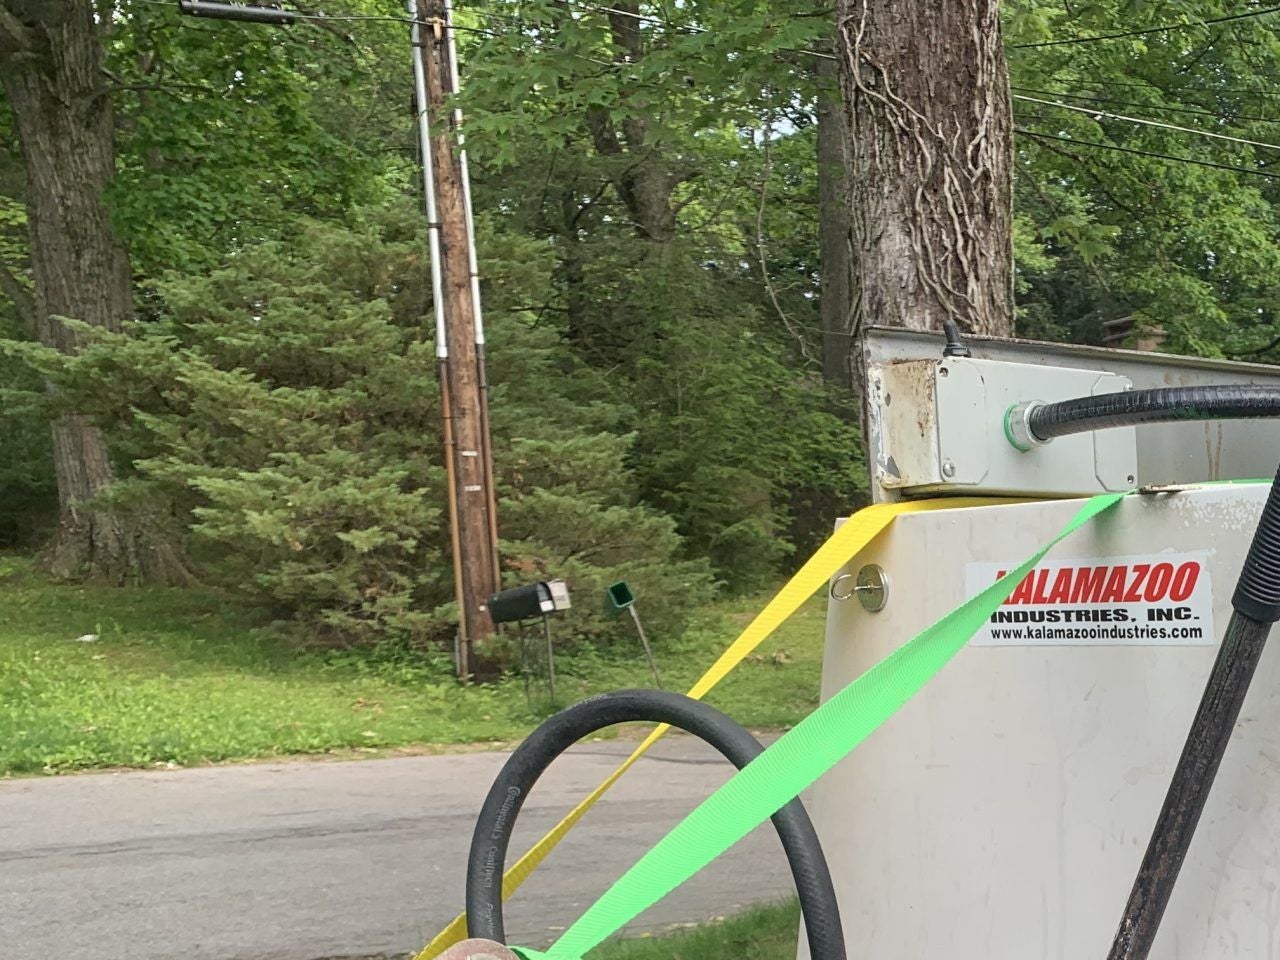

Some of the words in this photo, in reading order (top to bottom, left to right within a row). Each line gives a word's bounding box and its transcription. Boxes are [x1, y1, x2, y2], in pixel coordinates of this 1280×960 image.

[990, 608, 1137, 624] INDUSTRIES,
[1147, 606, 1200, 622] INC.
[990, 624, 1203, 640] www.kalamazooindustries.com
